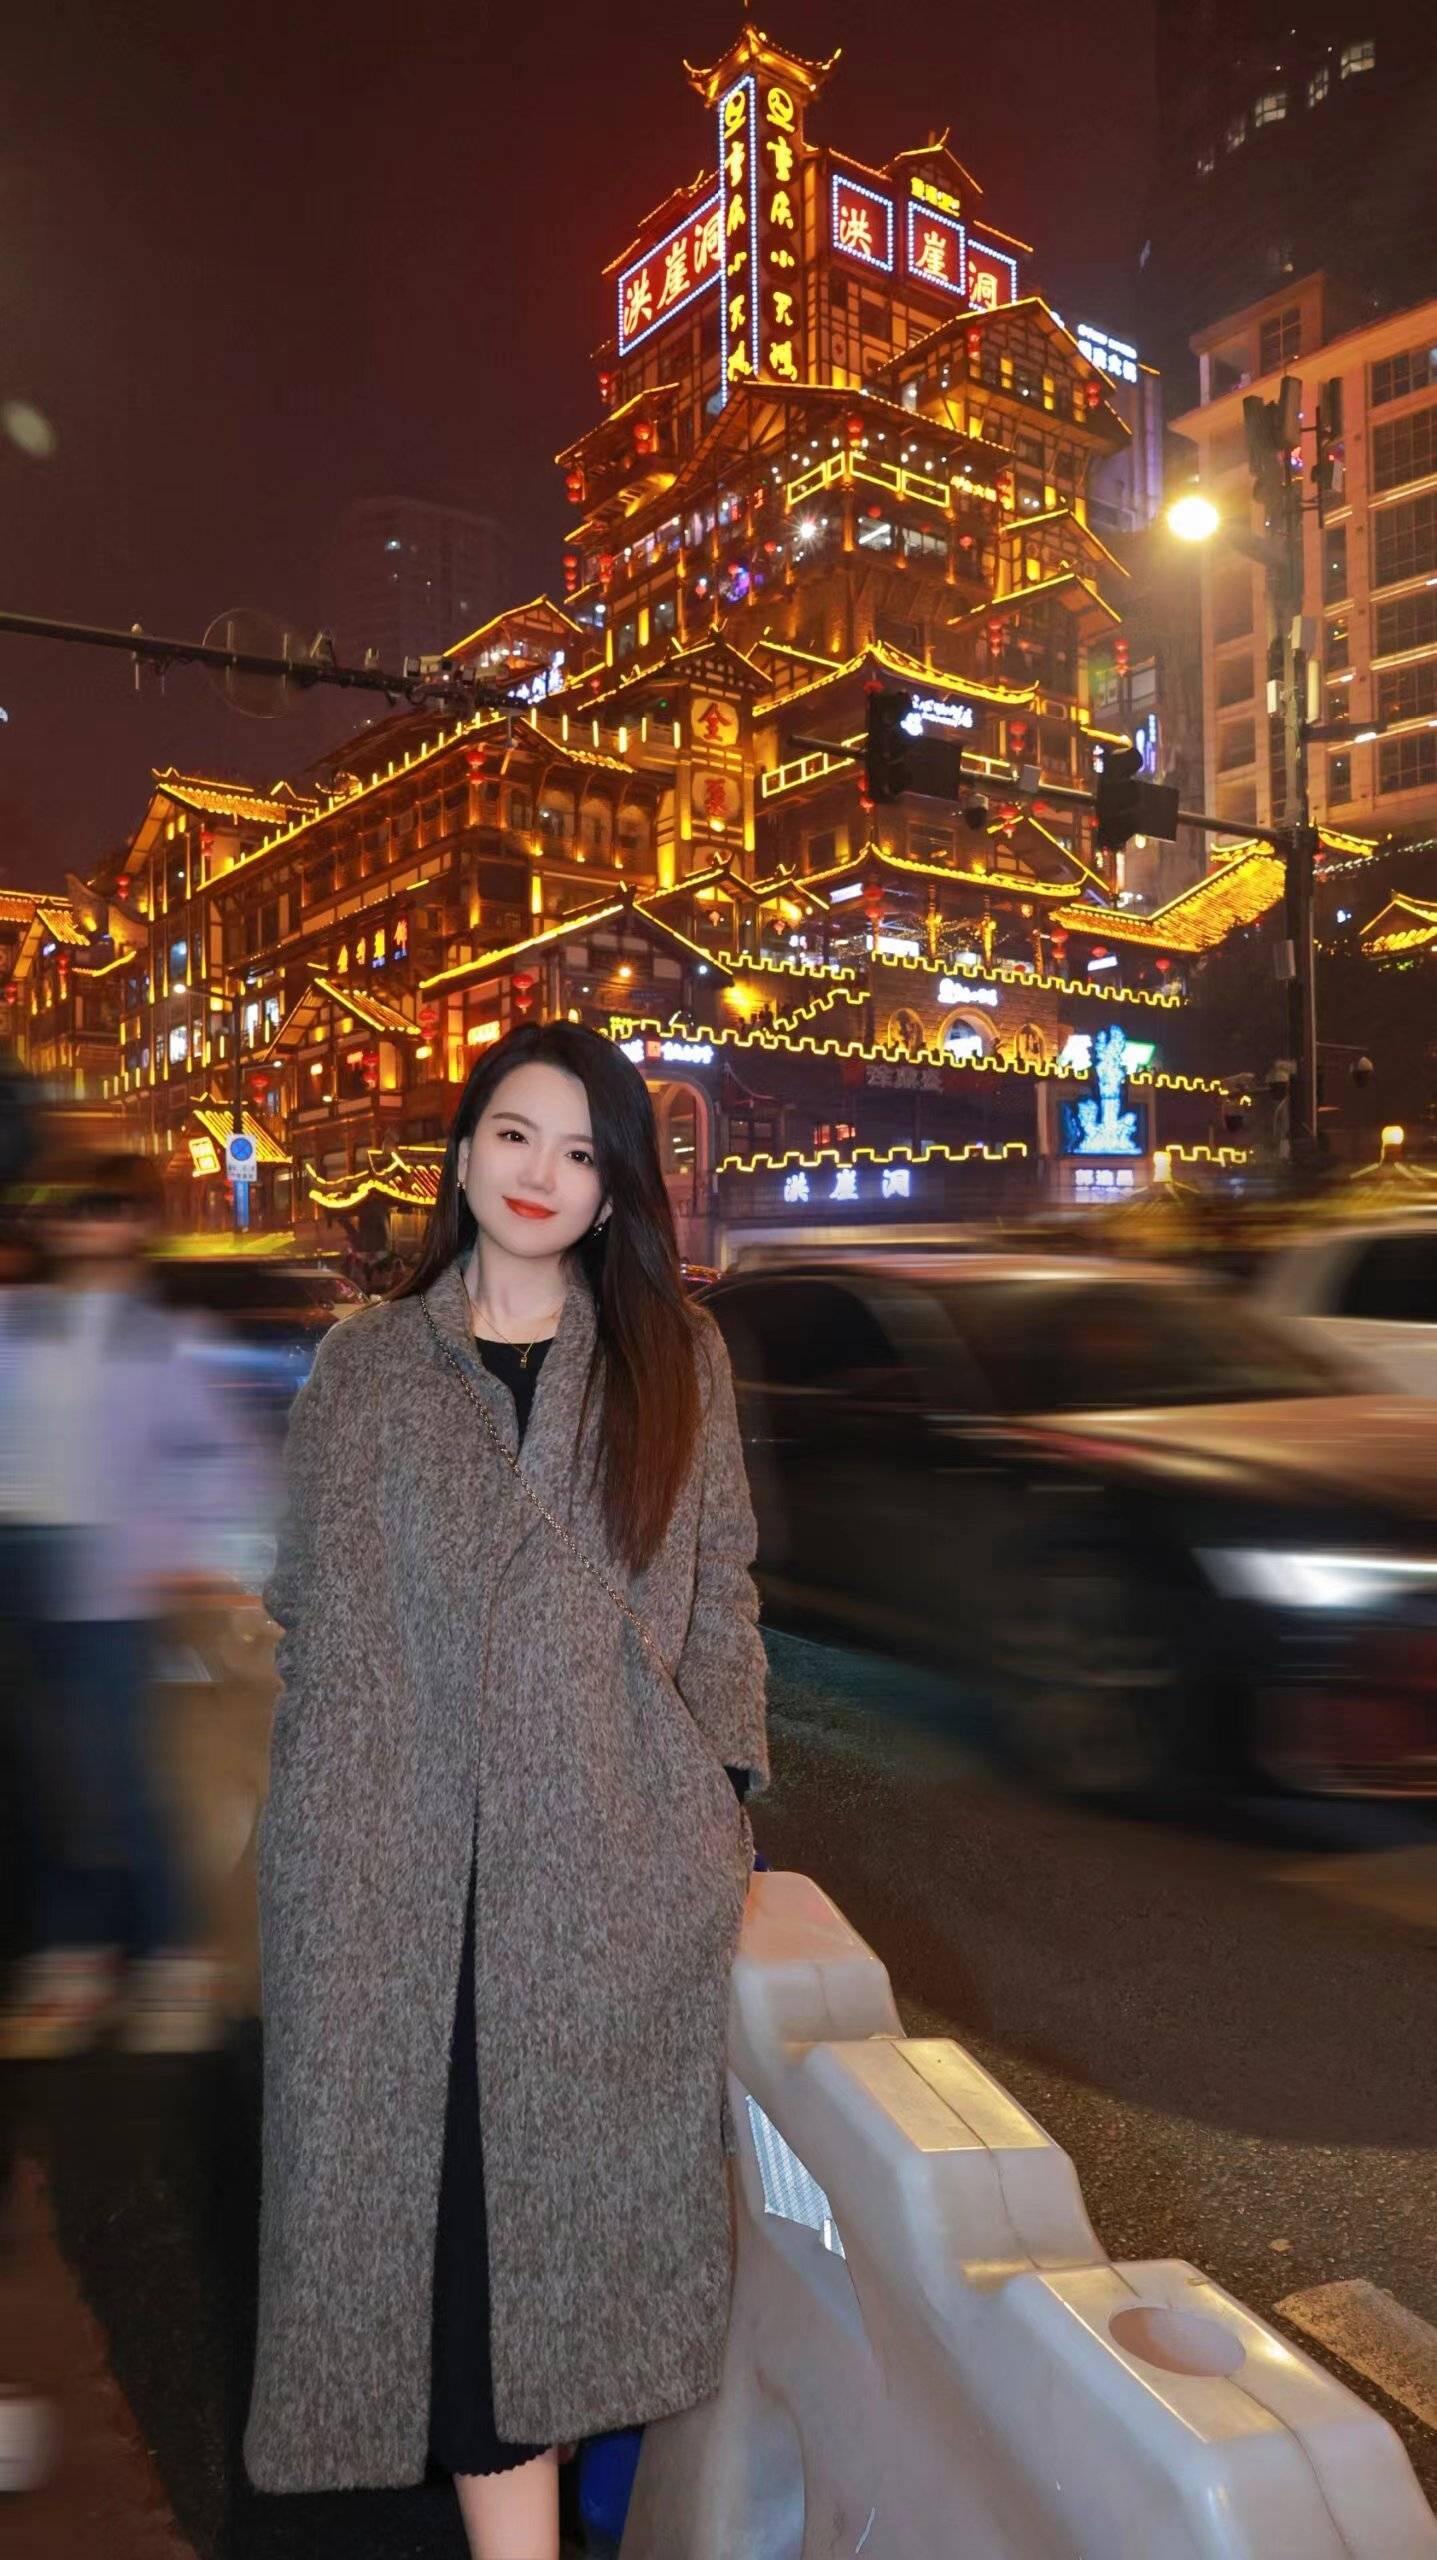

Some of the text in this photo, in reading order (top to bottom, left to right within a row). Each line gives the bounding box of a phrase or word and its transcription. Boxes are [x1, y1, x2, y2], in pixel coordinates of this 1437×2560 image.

[623, 209, 722, 336] 洪崖洞
[839, 205, 998, 310] 洪崖洞
[783, 1168, 910, 1202] 洪崖洞
